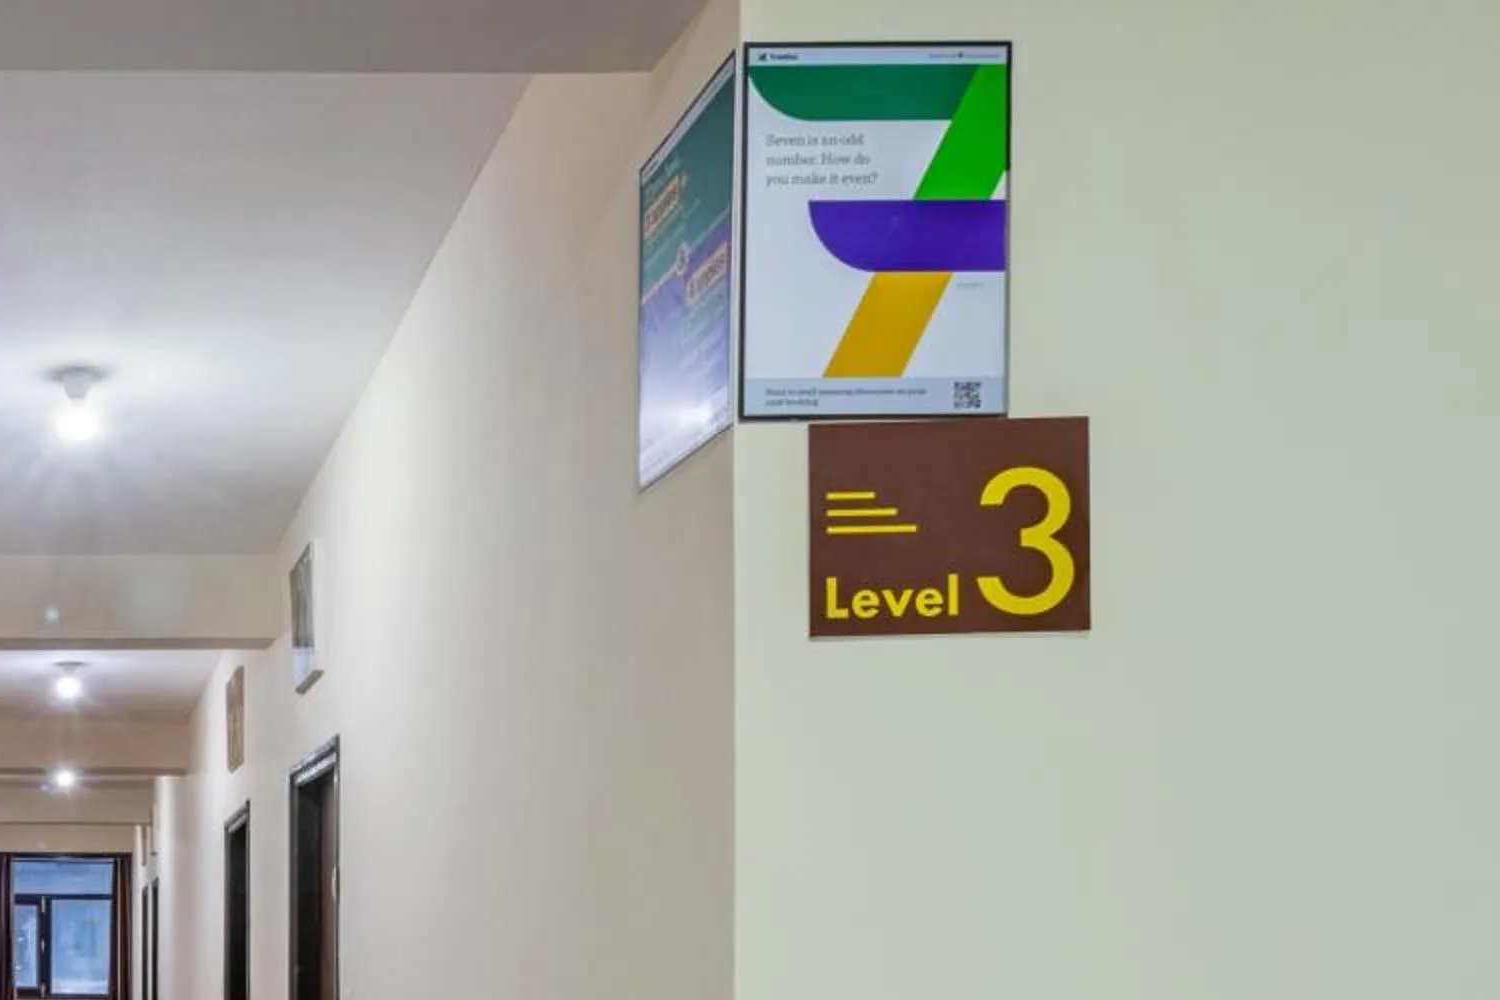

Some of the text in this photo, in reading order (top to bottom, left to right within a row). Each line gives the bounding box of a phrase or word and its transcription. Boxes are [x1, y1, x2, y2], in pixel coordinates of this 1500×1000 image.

[765, 132, 864, 147] Seven is an odd
[821, 152, 850, 165] How
[854, 152, 870, 165] do
[766, 172, 879, 188] you make it even?
[826, 466, 1075, 619] Level 3
